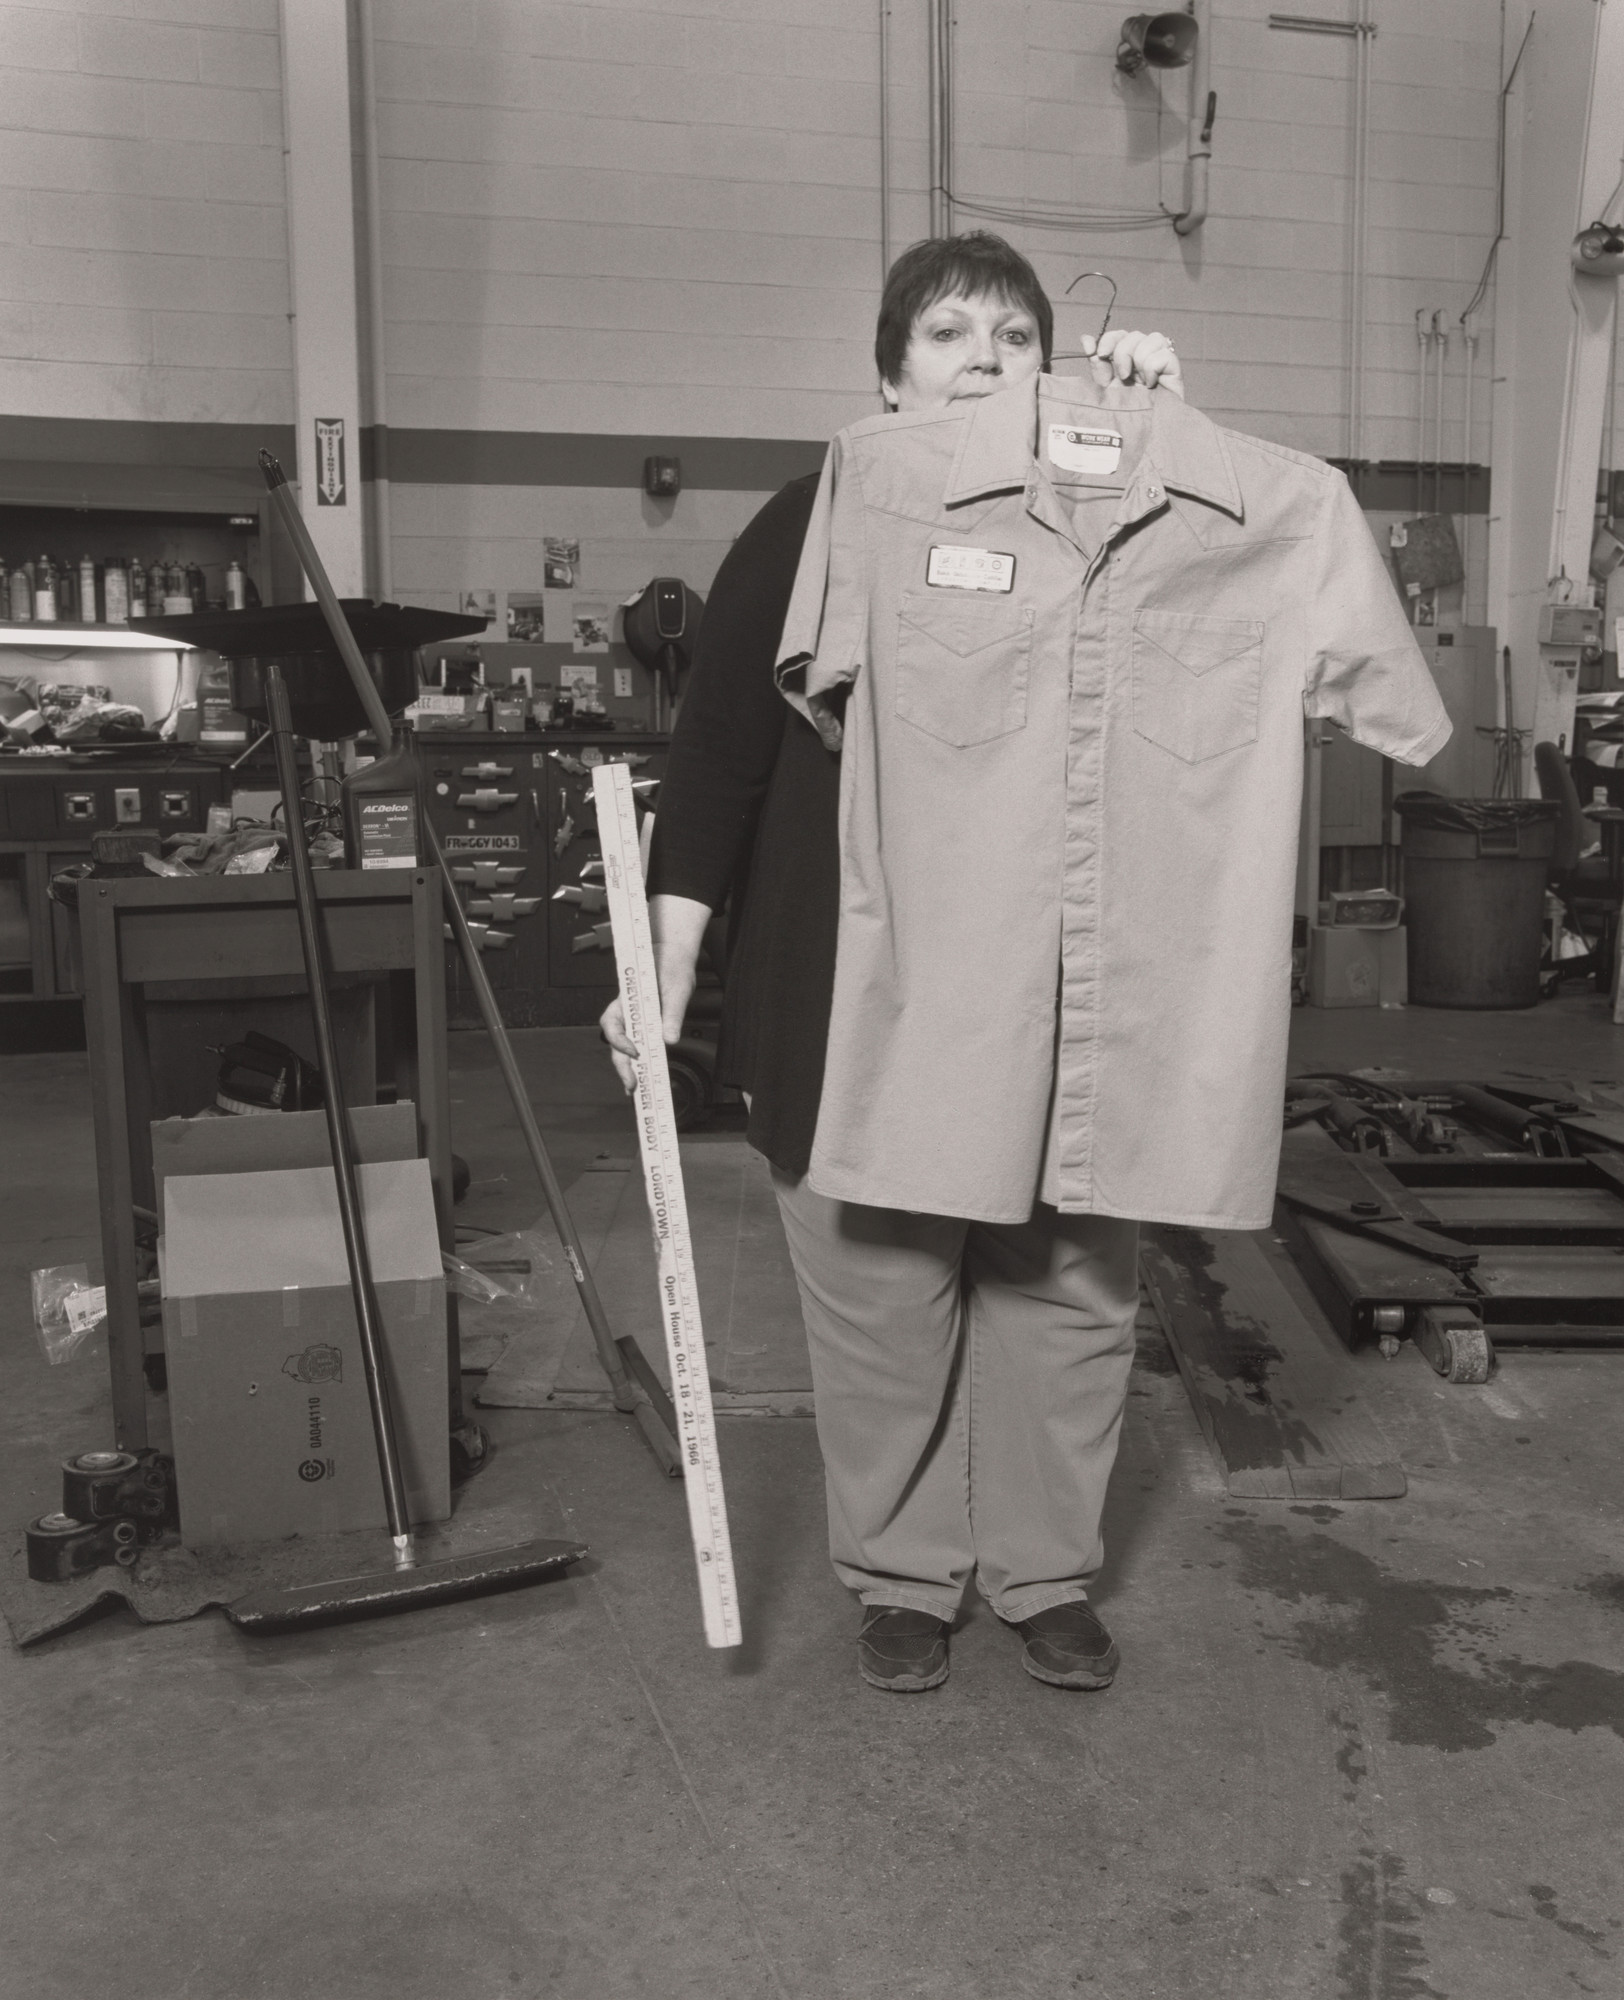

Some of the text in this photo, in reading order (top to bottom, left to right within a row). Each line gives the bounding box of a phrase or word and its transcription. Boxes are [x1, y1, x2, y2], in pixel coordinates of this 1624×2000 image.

[327, 436, 335, 498] EXTINGUISHER
[363, 804, 409, 813] ACDelco
[624, 966, 645, 1046] CHEVROLET
[637, 1063, 652, 1110] FISHER
[644, 1116, 659, 1152] BODY
[651, 1165, 670, 1240] LORDTOWN
[664, 1275, 676, 1306] Open
[670, 1311, 682, 1348] House
[675, 1353, 687, 1377] Oct.
[680, 1383, 691, 1398] 18
[683, 1410, 694, 1430] 21,
[686, 1436, 700, 1466] 1966
